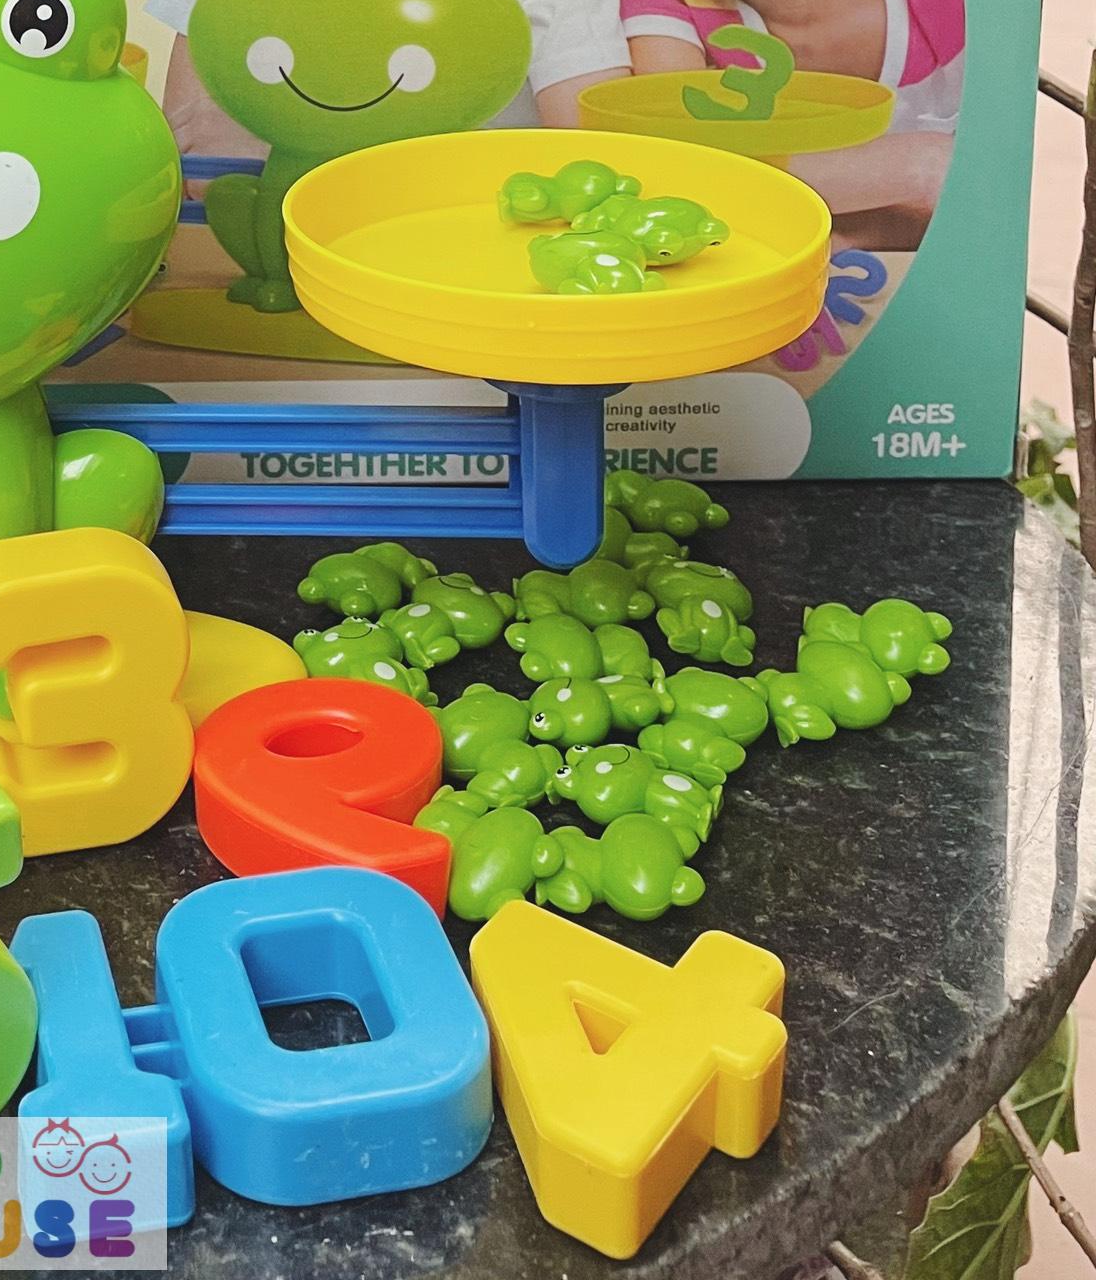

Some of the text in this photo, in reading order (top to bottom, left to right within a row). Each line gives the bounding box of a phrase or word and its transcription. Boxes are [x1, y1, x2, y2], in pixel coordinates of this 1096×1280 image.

[605, 402, 720, 417] ining aesthetic
[887, 403, 955, 424] AGES
[605, 420, 676, 434] creativity
[871, 432, 967, 458] 18M+
[240, 452, 447, 478] TOGEHTHER
[604, 447, 718, 475] RIENCE
